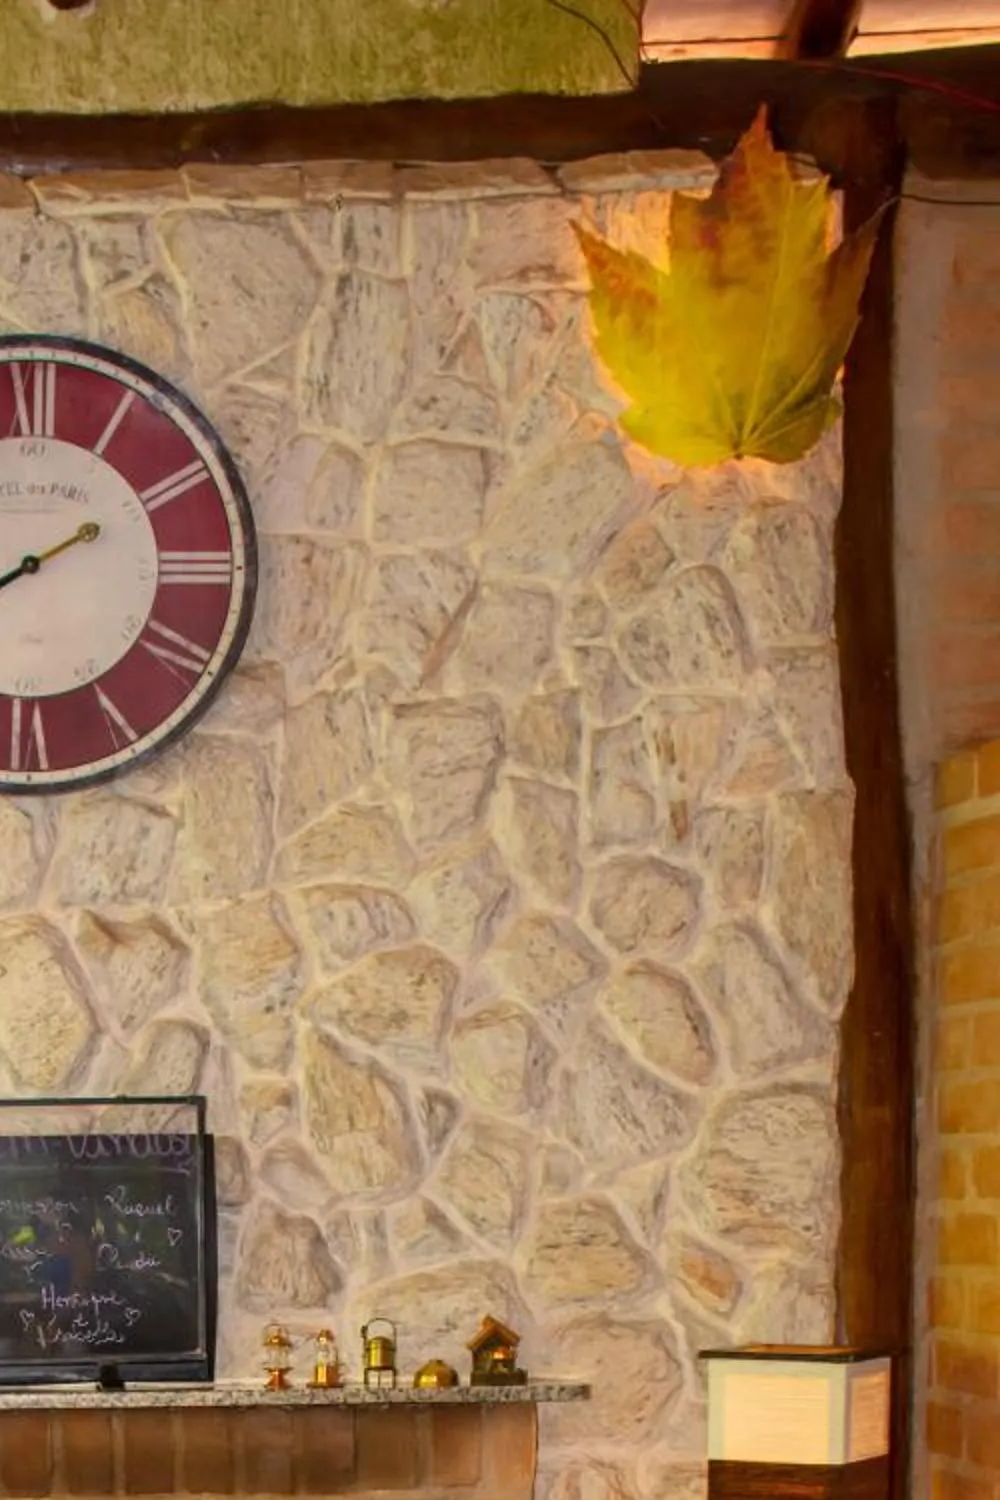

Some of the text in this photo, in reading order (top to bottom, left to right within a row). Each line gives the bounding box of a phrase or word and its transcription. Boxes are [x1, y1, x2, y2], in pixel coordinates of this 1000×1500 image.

[9, 361, 56, 437] XII
[93, 389, 136, 455] I
[20, 442, 47, 457] 60
[49, 481, 89, 504] PARIS
[139, 459, 211, 513] II
[159, 551, 232, 584] III
[137, 619, 212, 691] IV
[11, 698, 48, 770] VI
[93, 681, 139, 750] V
